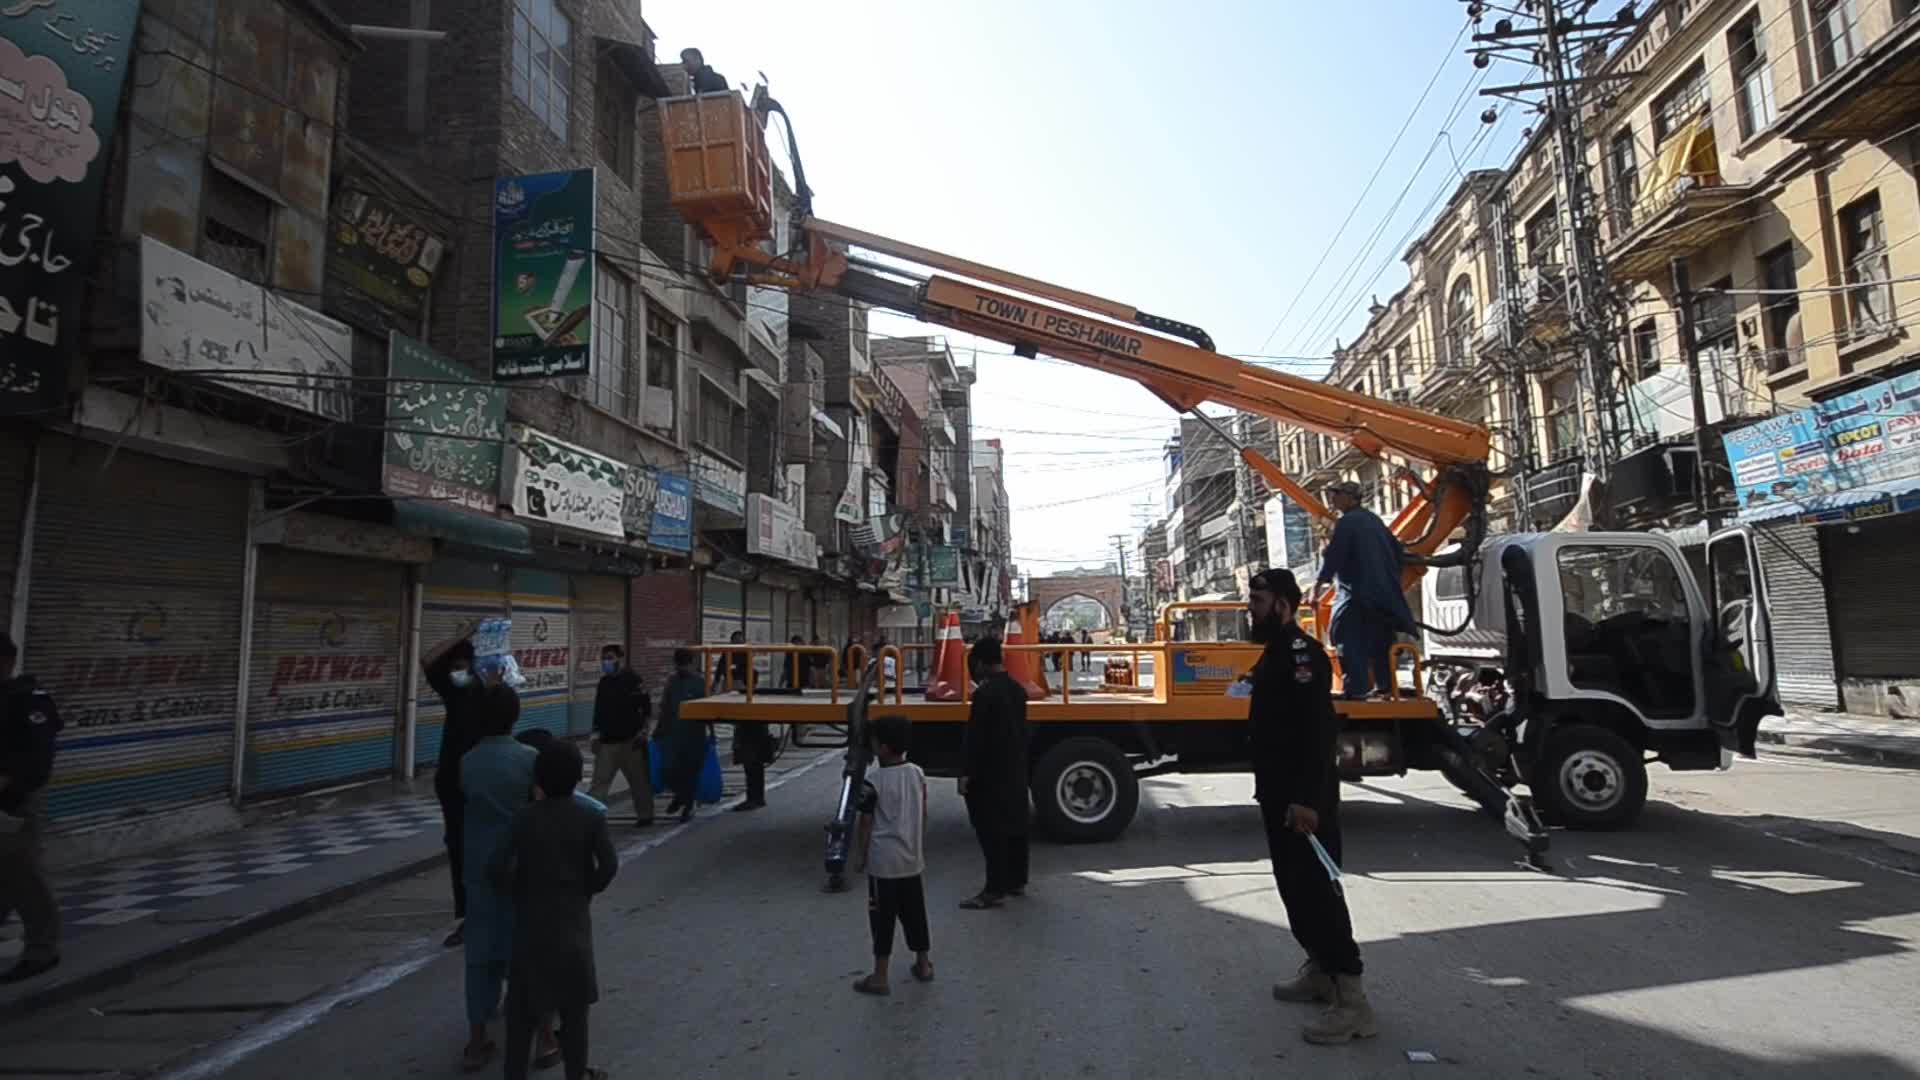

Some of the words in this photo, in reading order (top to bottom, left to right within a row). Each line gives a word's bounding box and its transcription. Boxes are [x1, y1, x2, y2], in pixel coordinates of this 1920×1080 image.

[976, 294, 1027, 322] TOWN
[1043, 314, 1142, 355] PESHAWAR
[1728, 413, 1803, 444] PESHAWAR
[1744, 432, 1793, 455] SHOES
[1837, 443, 1884, 462] Bata
[268, 655, 385, 697] parwaz
